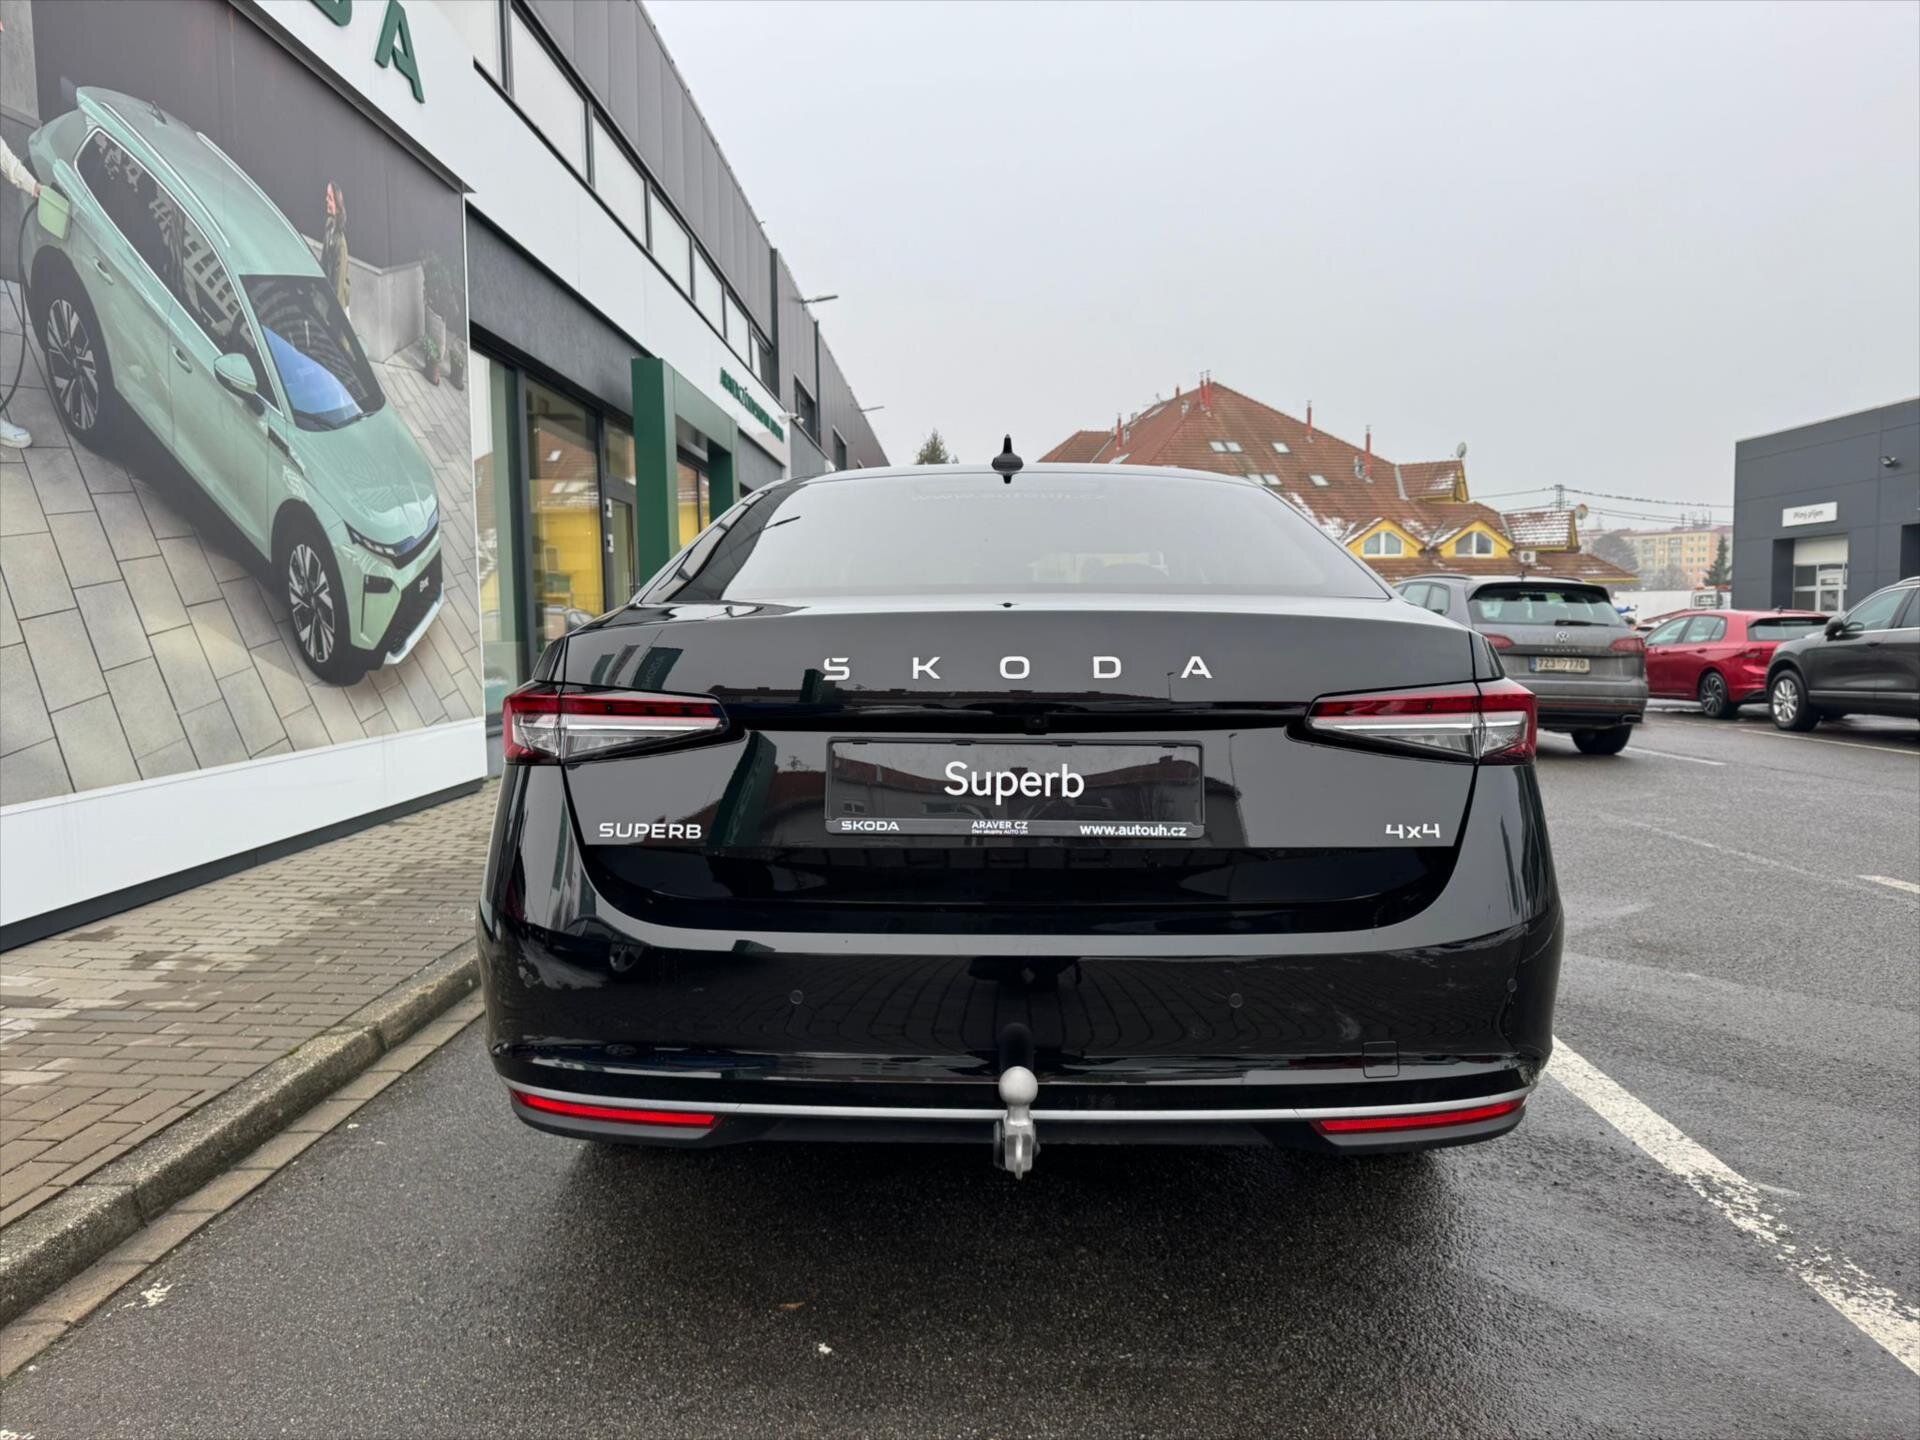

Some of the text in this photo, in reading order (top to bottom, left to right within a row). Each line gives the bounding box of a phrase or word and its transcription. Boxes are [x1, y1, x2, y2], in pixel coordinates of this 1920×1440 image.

[944, 760, 1085, 806] Superb
[598, 822, 702, 839] SUPERB
[971, 820, 1029, 829] ARAVER CZ
[1079, 823, 1188, 837] www.autouh.cz
[1385, 823, 1442, 839] 4x4
